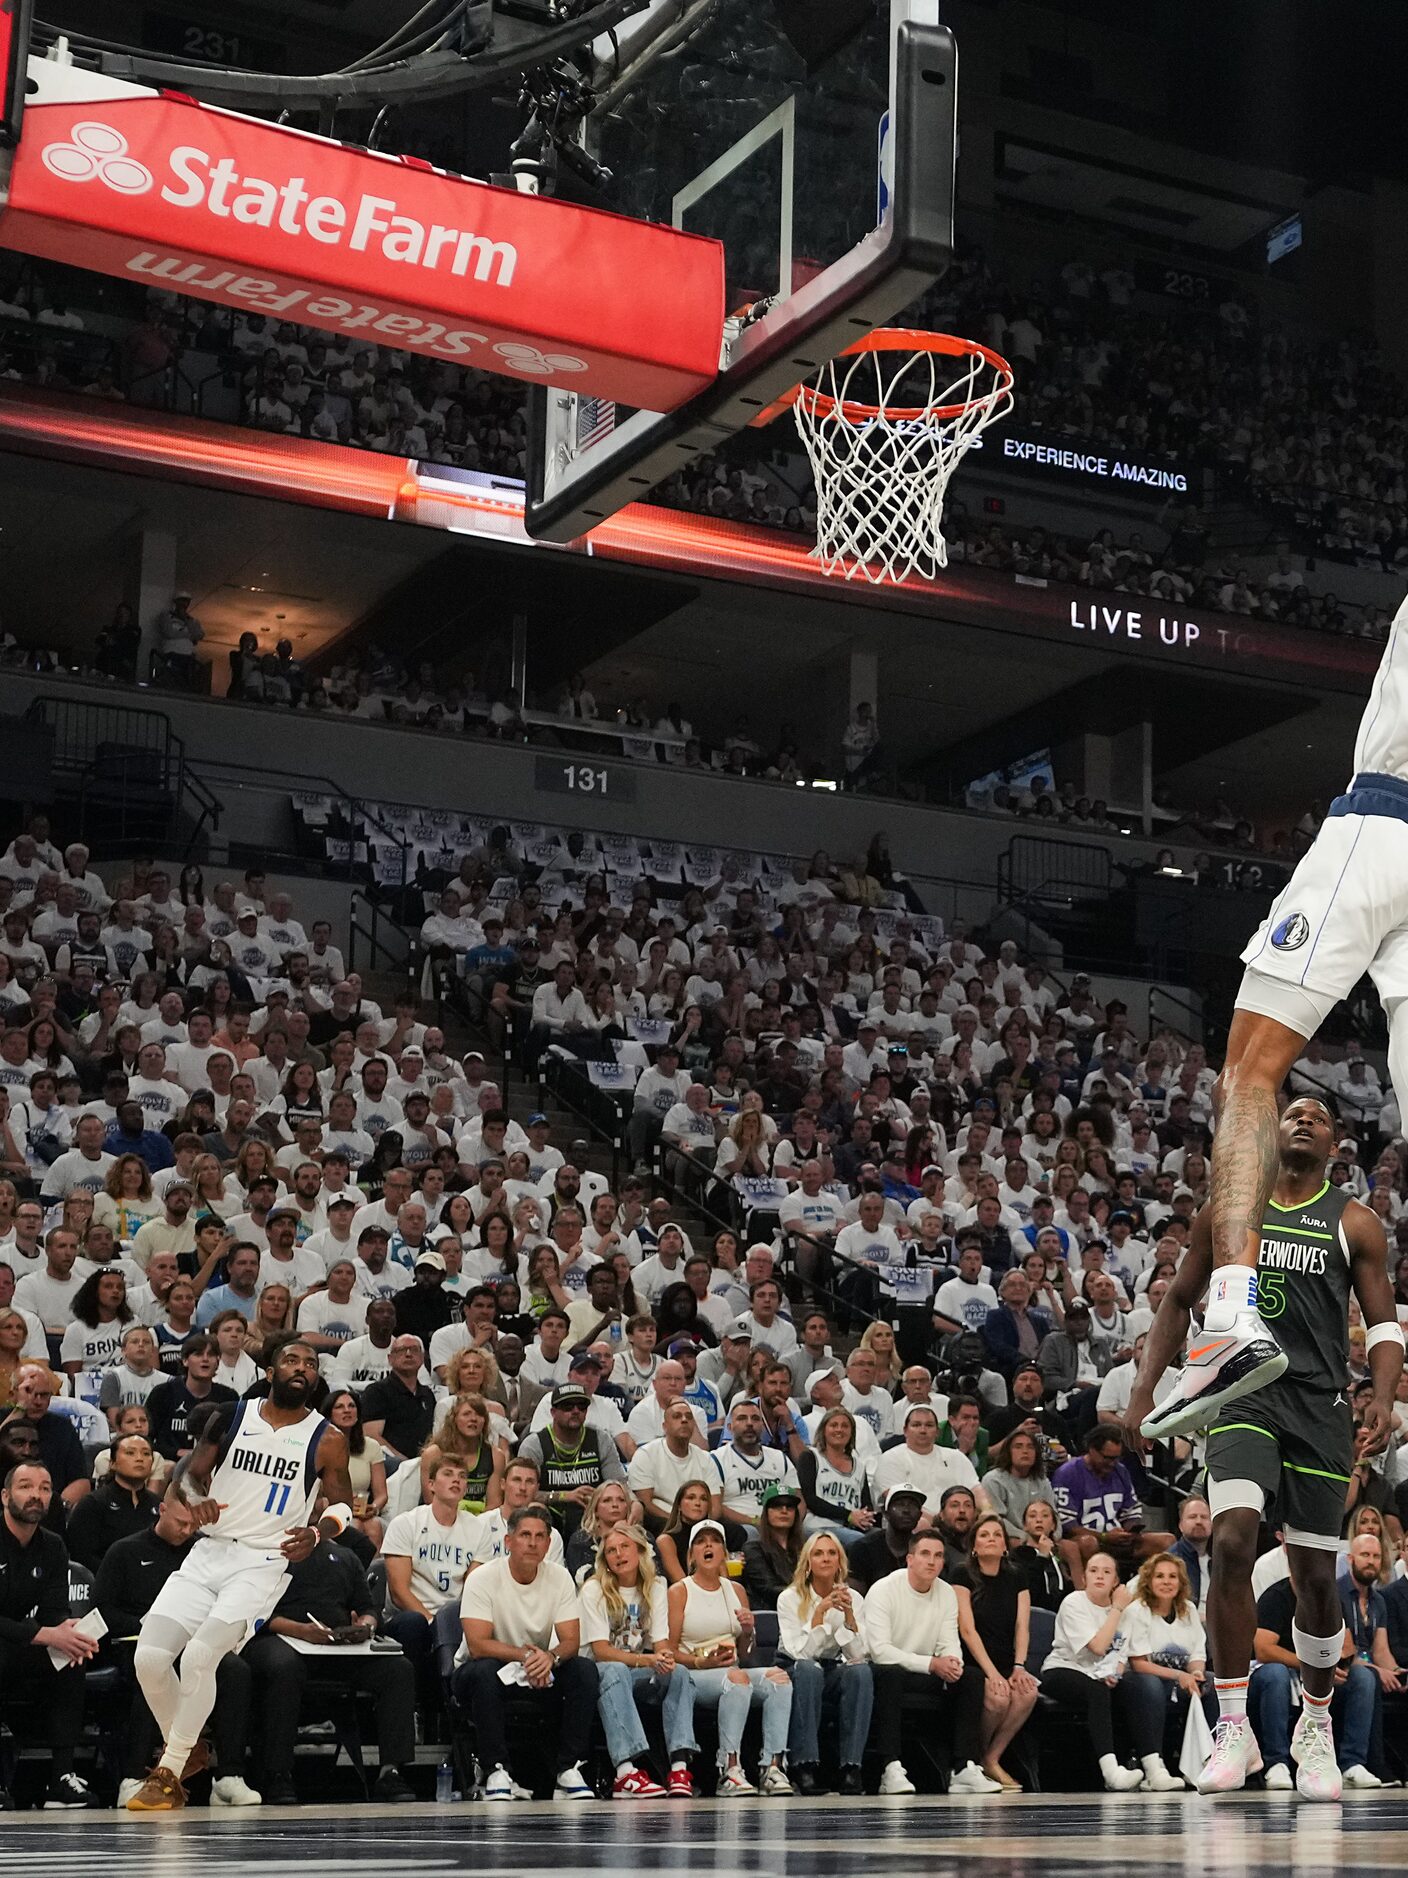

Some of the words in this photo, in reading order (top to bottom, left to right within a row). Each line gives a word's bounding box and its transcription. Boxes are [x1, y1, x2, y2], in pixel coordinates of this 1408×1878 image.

[1004, 438, 1107, 476] EXPERIENCE
[1111, 461, 1188, 493] AMAZING
[1070, 601, 1142, 639] LIVE
[1159, 617, 1200, 647] UP
[563, 765, 608, 794] 131
[1258, 1239, 1329, 1276] ERWOLVES
[1257, 1270, 1287, 1320] 5
[86, 1337, 121, 1357] BRIN
[231, 1448, 300, 1481] DALLAS
[264, 1481, 291, 1516] 11
[822, 1484, 859, 1508] WOLVES
[1081, 1493, 1123, 1534] 55
[419, 1544, 473, 1568] WOLVES
[438, 1571, 450, 1592] 5
